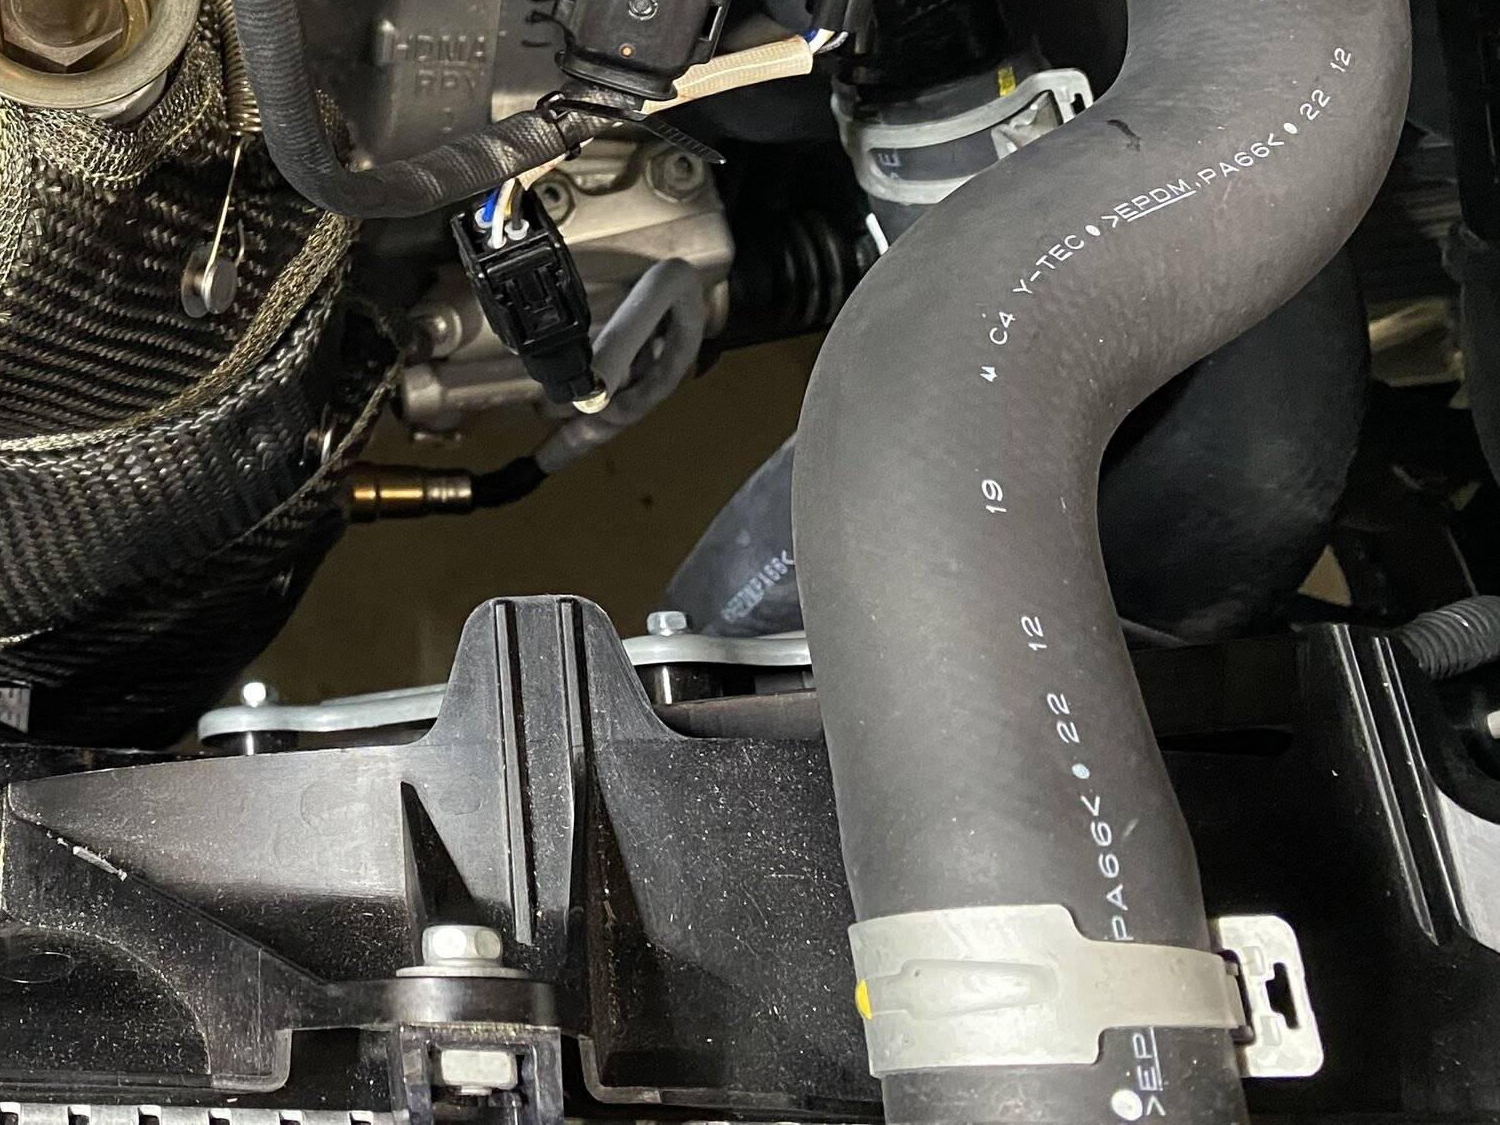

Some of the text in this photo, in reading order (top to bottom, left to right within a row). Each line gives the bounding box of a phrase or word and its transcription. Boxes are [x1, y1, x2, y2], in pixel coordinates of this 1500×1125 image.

[989, 311, 1016, 345] C4
[1012, 234, 1085, 294] Y-TEC
[1299, 89, 1331, 121] 22
[1330, 47, 1352, 73] 12
[981, 478, 1007, 514] 19
[1020, 615, 1048, 651] 12
[1046, 692, 1080, 744] 22
